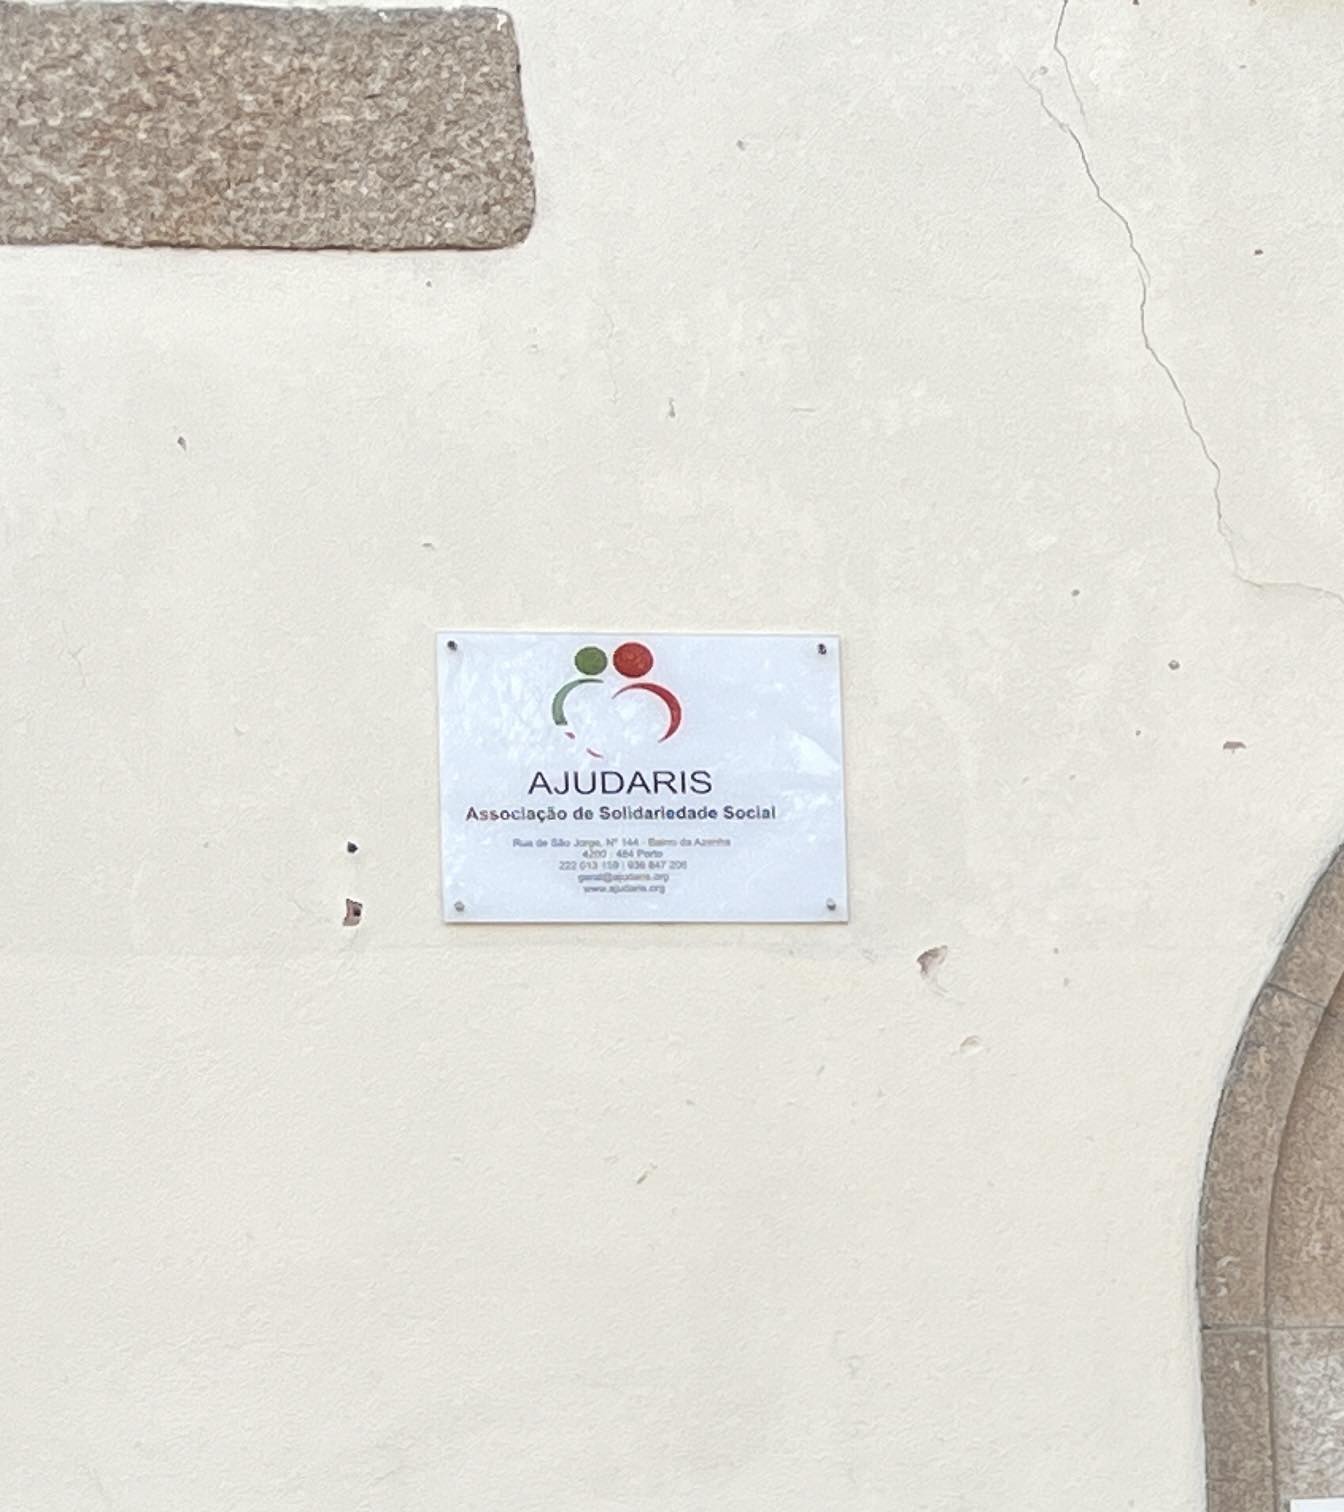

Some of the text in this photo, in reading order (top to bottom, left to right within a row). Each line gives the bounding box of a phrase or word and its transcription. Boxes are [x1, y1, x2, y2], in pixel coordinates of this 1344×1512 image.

[528, 771, 713, 795] AJUDARIS
[465, 805, 776, 823] Associação de Solidariedade Social
[512, 838, 533, 847] Rua
[535, 838, 548, 847] de
[551, 837, 571, 847] São
[679, 837, 692, 847] da
[582, 849, 607, 858] 4200
[636, 849, 664, 858] Porto
[558, 860, 577, 870] 222
[583, 884, 666, 894] www.ajudaris.org
